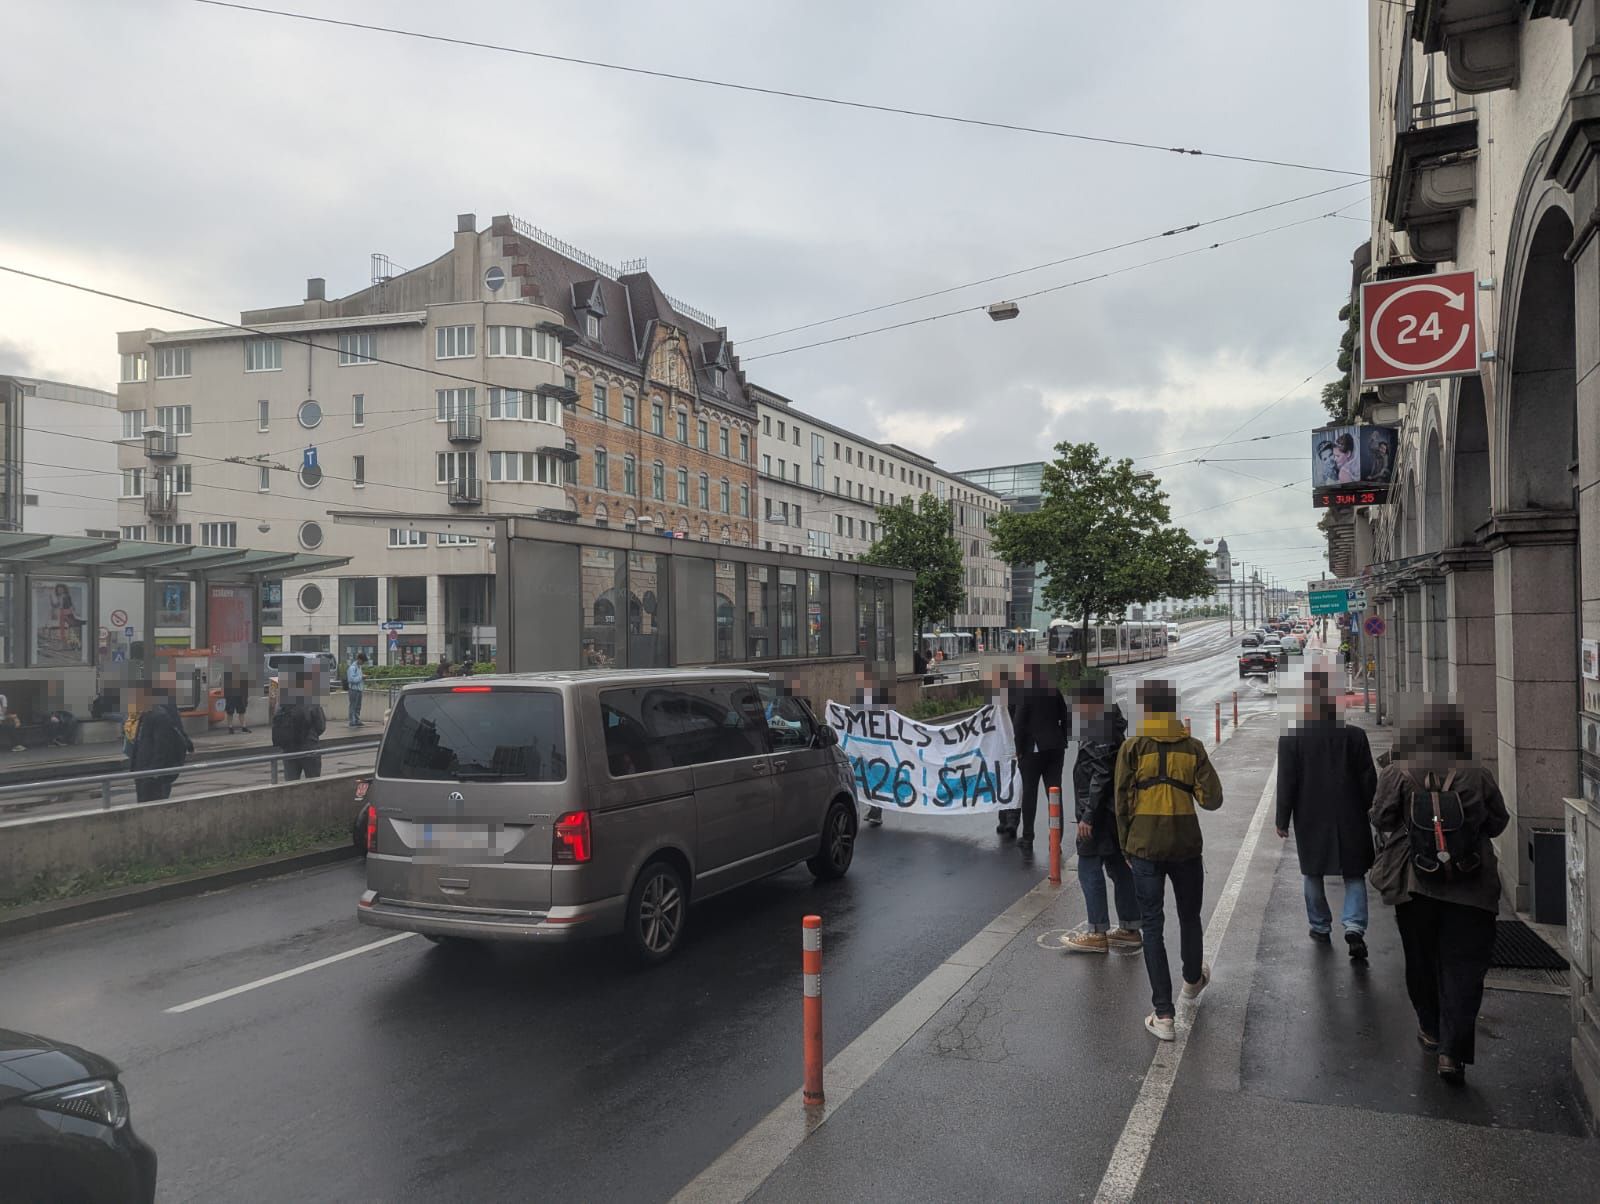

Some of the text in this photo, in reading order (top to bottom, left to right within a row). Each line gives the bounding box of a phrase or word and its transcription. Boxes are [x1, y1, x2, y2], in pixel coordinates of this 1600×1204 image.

[1397, 311, 1444, 345] 24
[1335, 495, 1355, 504] JUN
[1361, 493, 1375, 503] 25
[829, 703, 996, 747] SMELLS LIKE
[852, 756, 1017, 808] A26 STAU
